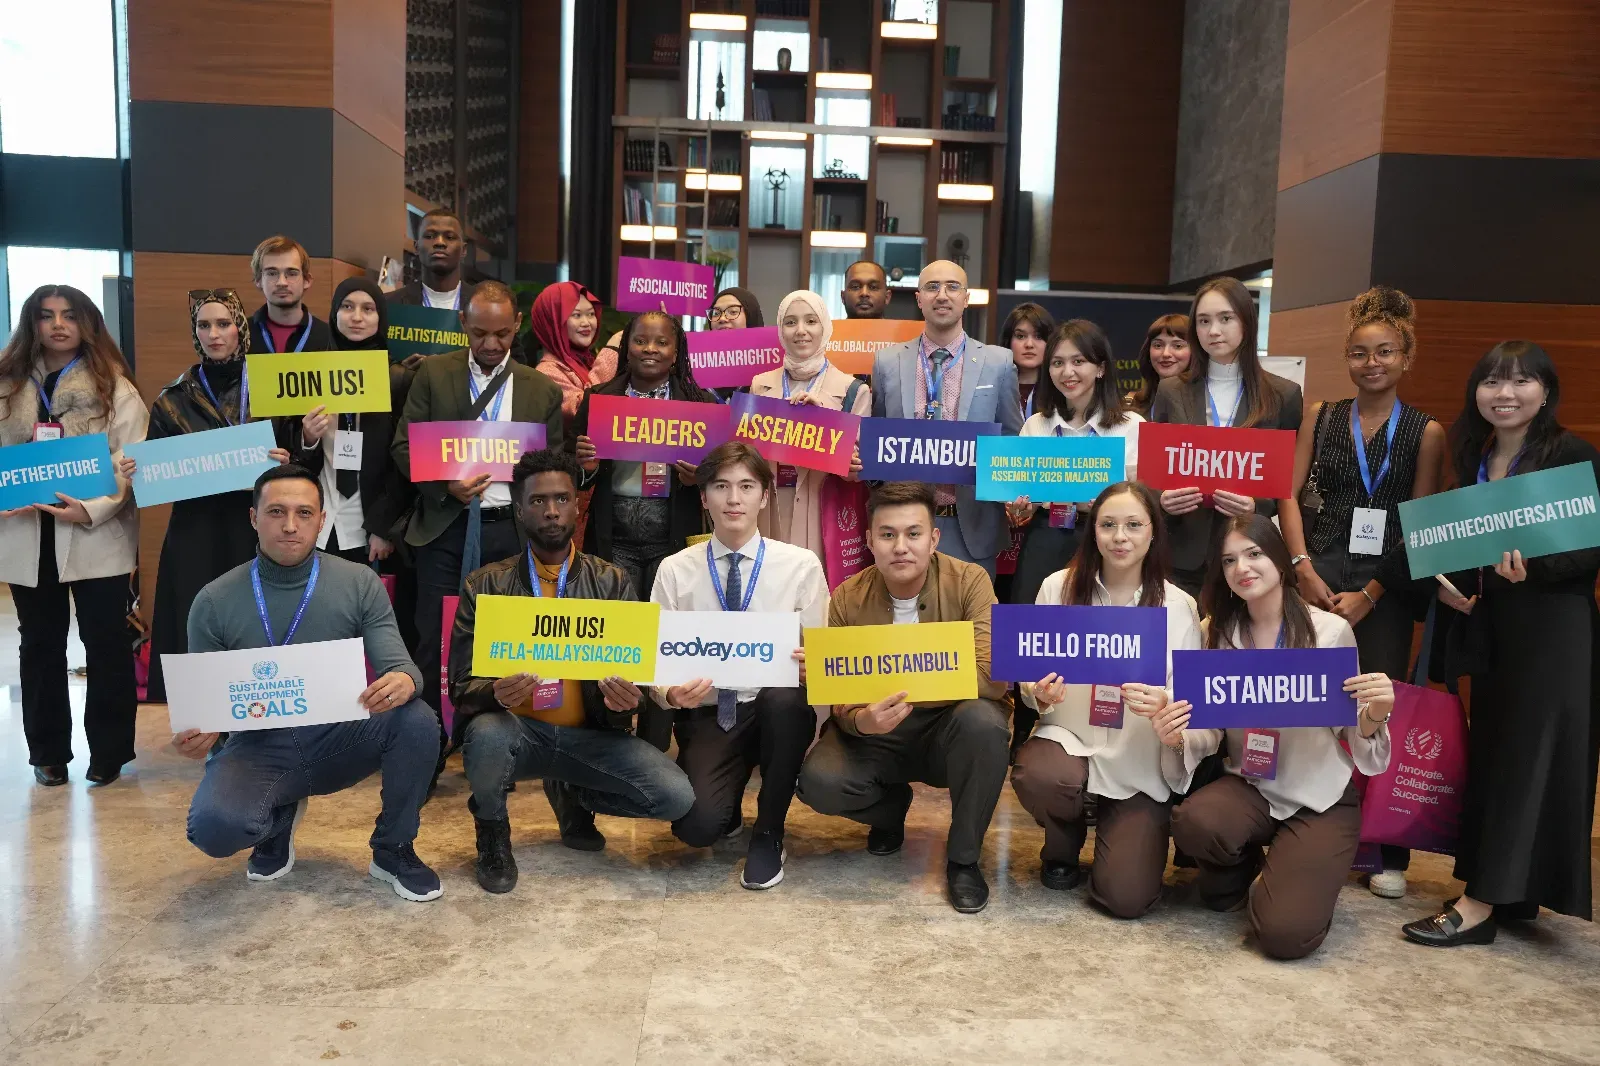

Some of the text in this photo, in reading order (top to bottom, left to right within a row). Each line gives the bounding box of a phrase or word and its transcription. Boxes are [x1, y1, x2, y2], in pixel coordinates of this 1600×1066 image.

[629, 277, 708, 300] #SOCIALJUSTICE
[387, 325, 470, 347] #FLATISTANBUL
[689, 347, 780, 369] HUMANRIGHTS
[276, 370, 323, 399] JOIN
[329, 369, 365, 396] US!
[611, 415, 707, 448] LEADERS
[735, 412, 844, 455] ASSEMBLY
[441, 438, 520, 464] FUTURE
[877, 436, 977, 467] ISTANBUL
[990, 456, 1111, 469] JOIN US AT FUTURE LEADERS
[1164, 442, 1266, 481] TÜRKIYE
[0, 458, 101, 488] PETHEFUTURE
[142, 445, 269, 484] #POLICYMATTERS
[991, 470, 1109, 483] ASSEMBLY 2026 MALAYSIA
[1409, 495, 1597, 549] #JOINTHECONVERSATION
[532, 614, 605, 639] JOIN US!
[489, 641, 642, 664] #FLA-MALAYSIA2026
[1018, 632, 1141, 659] HELLO FROM
[824, 651, 959, 677] HELLO ISTANBUL!
[229, 679, 305, 693] SUSTAINABLE
[229, 688, 305, 702] DEVELOPMENT
[1204, 674, 1327, 705] ISTANBUL!
[231, 697, 308, 720] GOALS
[1397, 762, 1445, 781] Innovate.
[1392, 787, 1439, 805] Succeed.
[1395, 775, 1456, 794] Collaborate.
